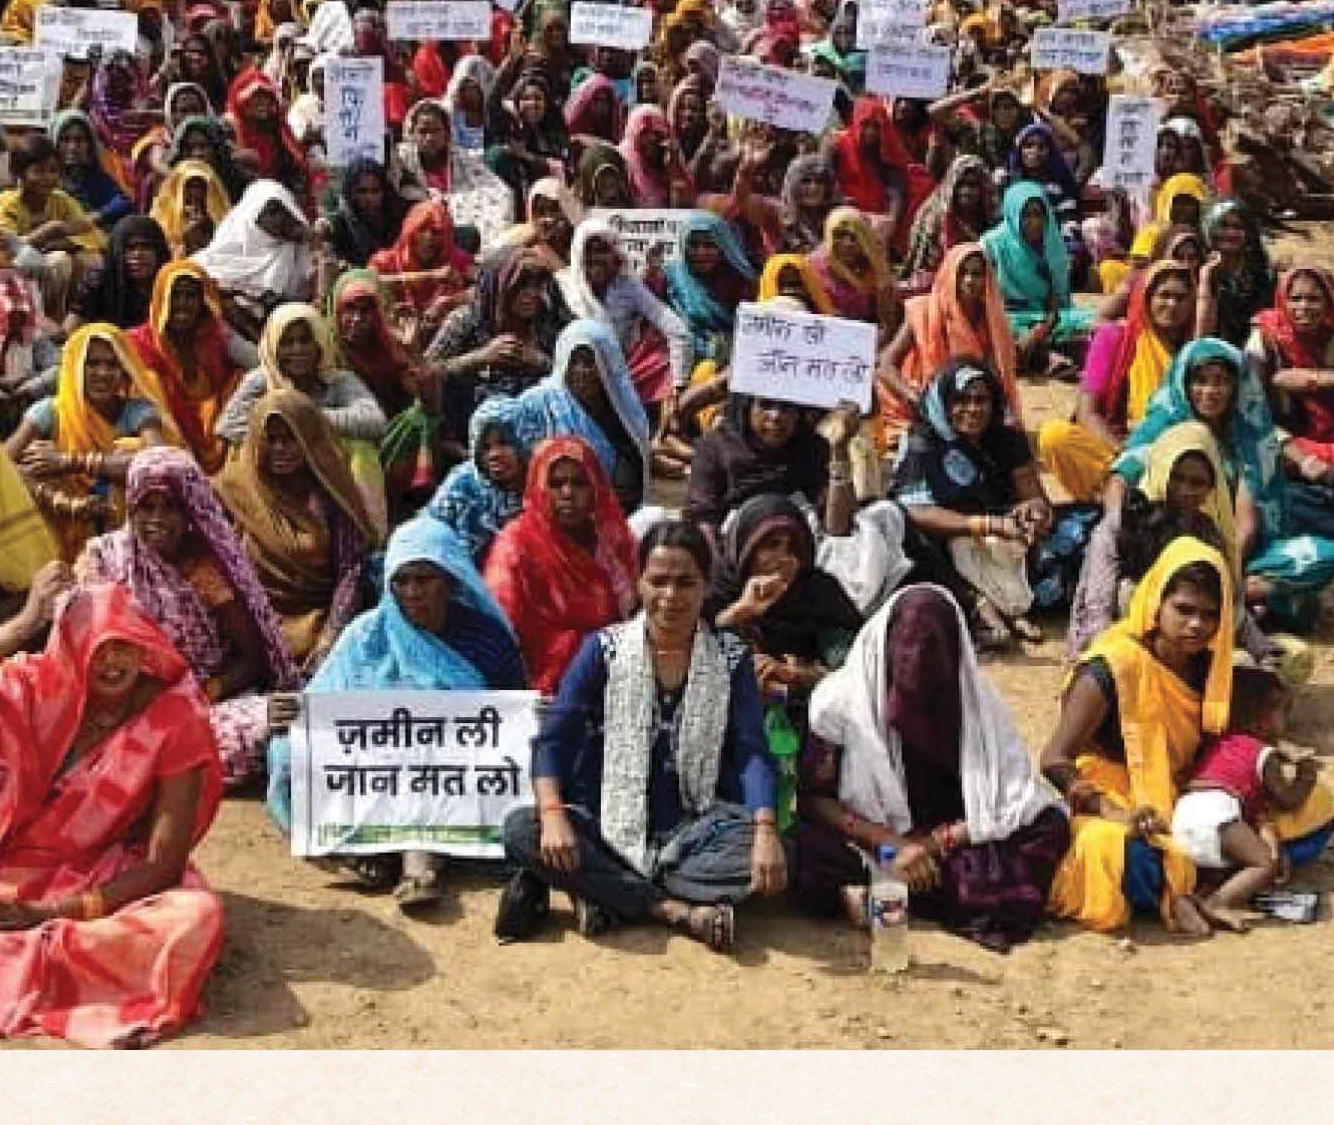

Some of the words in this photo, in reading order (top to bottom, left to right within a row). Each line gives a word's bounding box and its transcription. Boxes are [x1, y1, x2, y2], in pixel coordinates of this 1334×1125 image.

[333, 707, 448, 755] ज़मीन
[452, 705, 502, 749] ली
[323, 763, 403, 796] जान
[408, 763, 468, 796] मत
[473, 755, 522, 796] लो
